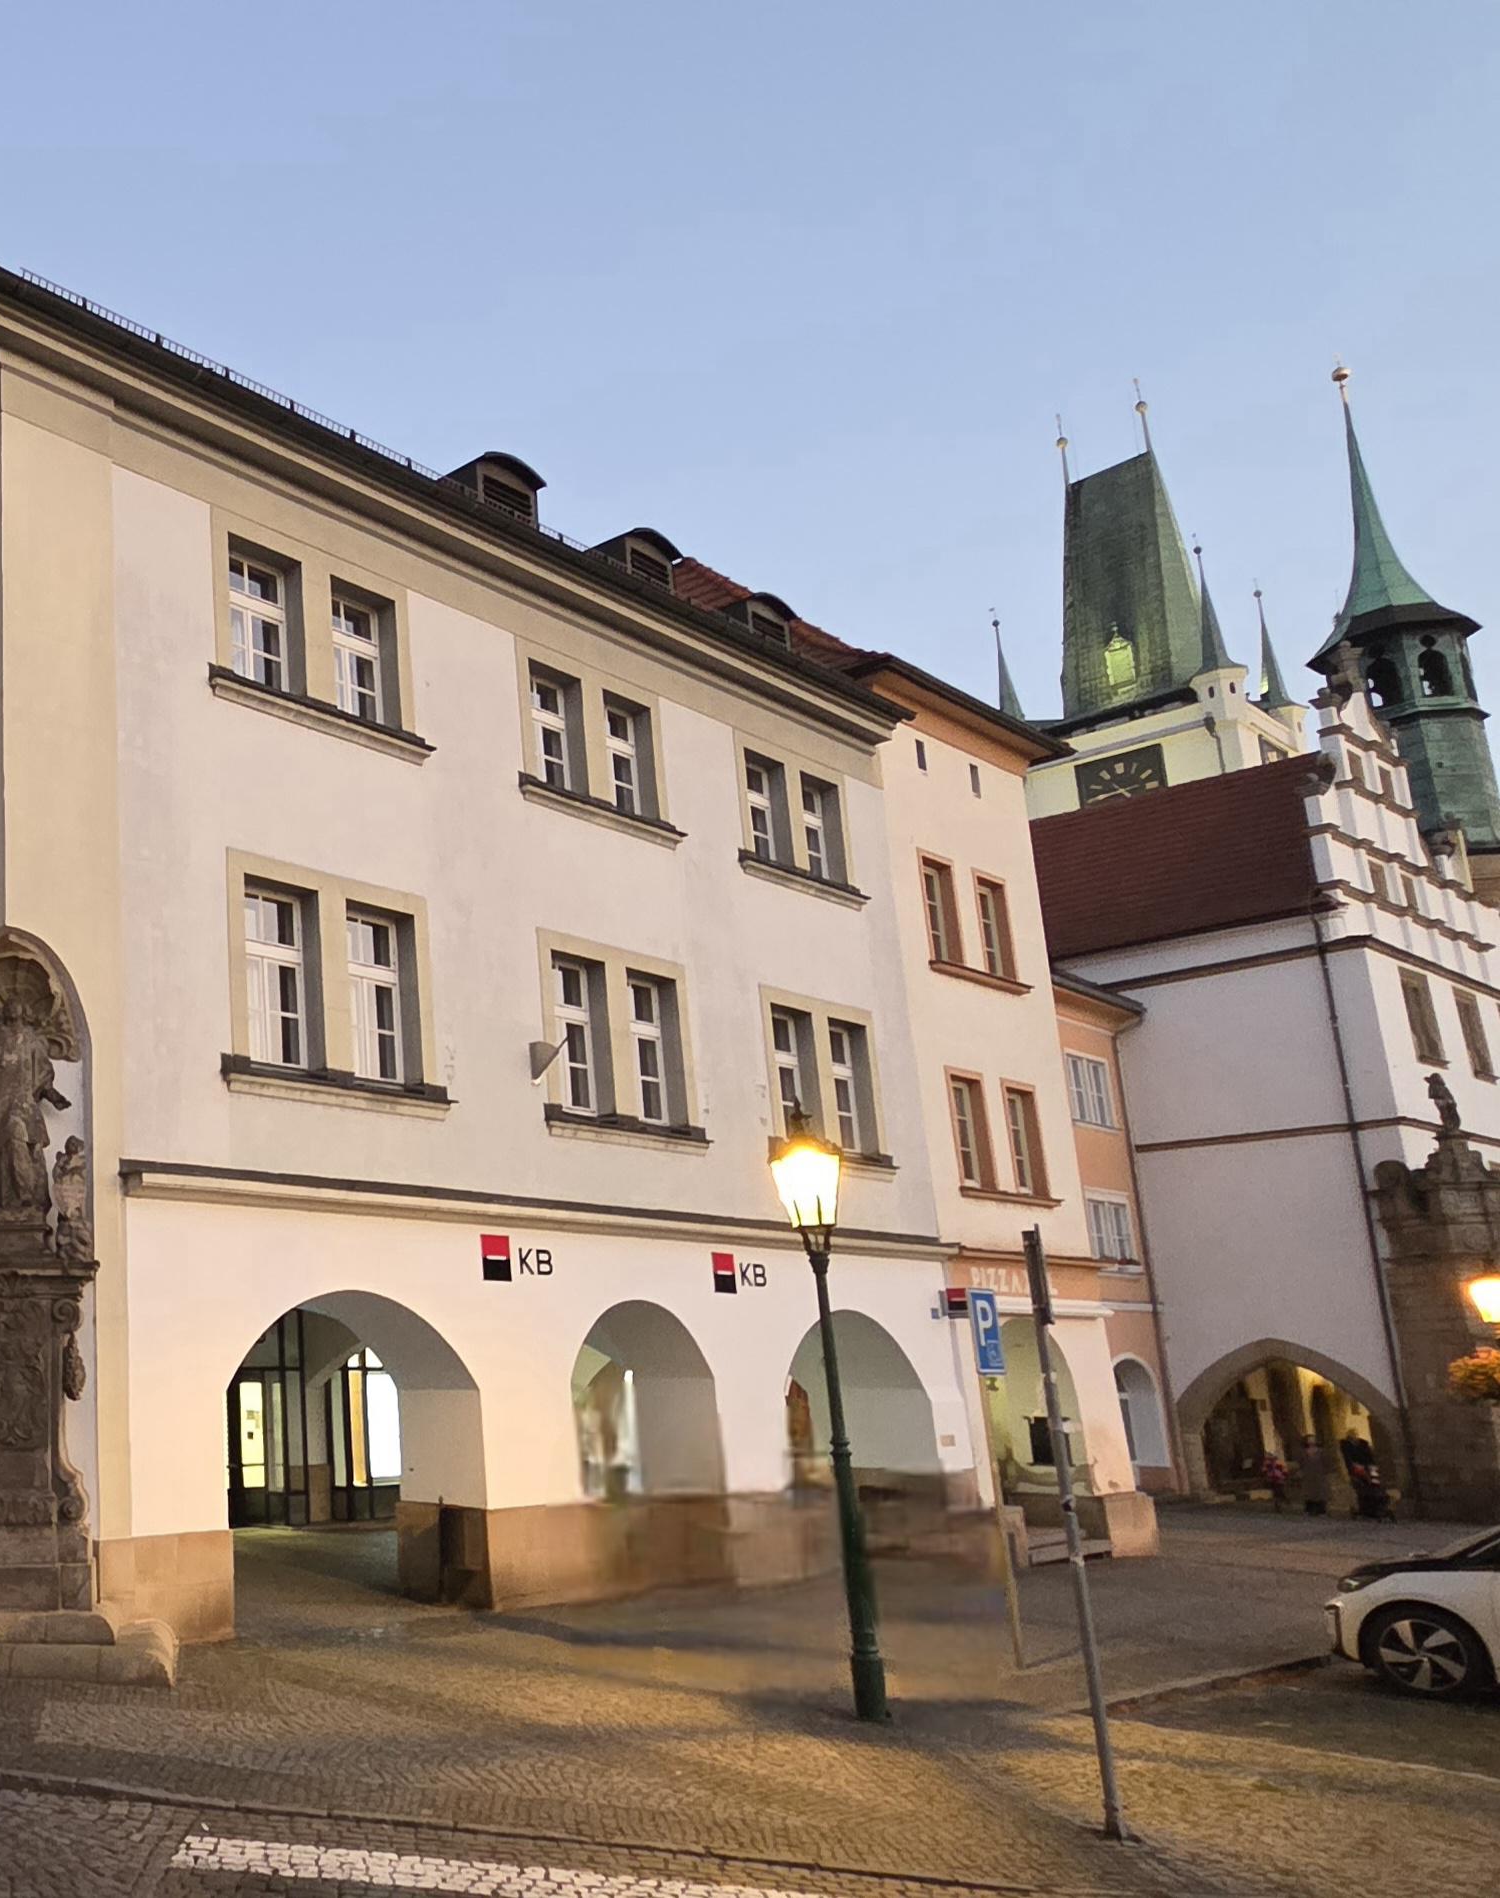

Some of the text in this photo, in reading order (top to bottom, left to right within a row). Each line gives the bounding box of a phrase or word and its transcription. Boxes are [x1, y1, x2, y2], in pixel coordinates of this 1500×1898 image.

[518, 1247, 553, 1275] KB
[739, 1262, 767, 1287] KB
[976, 1300, 993, 1346] P
